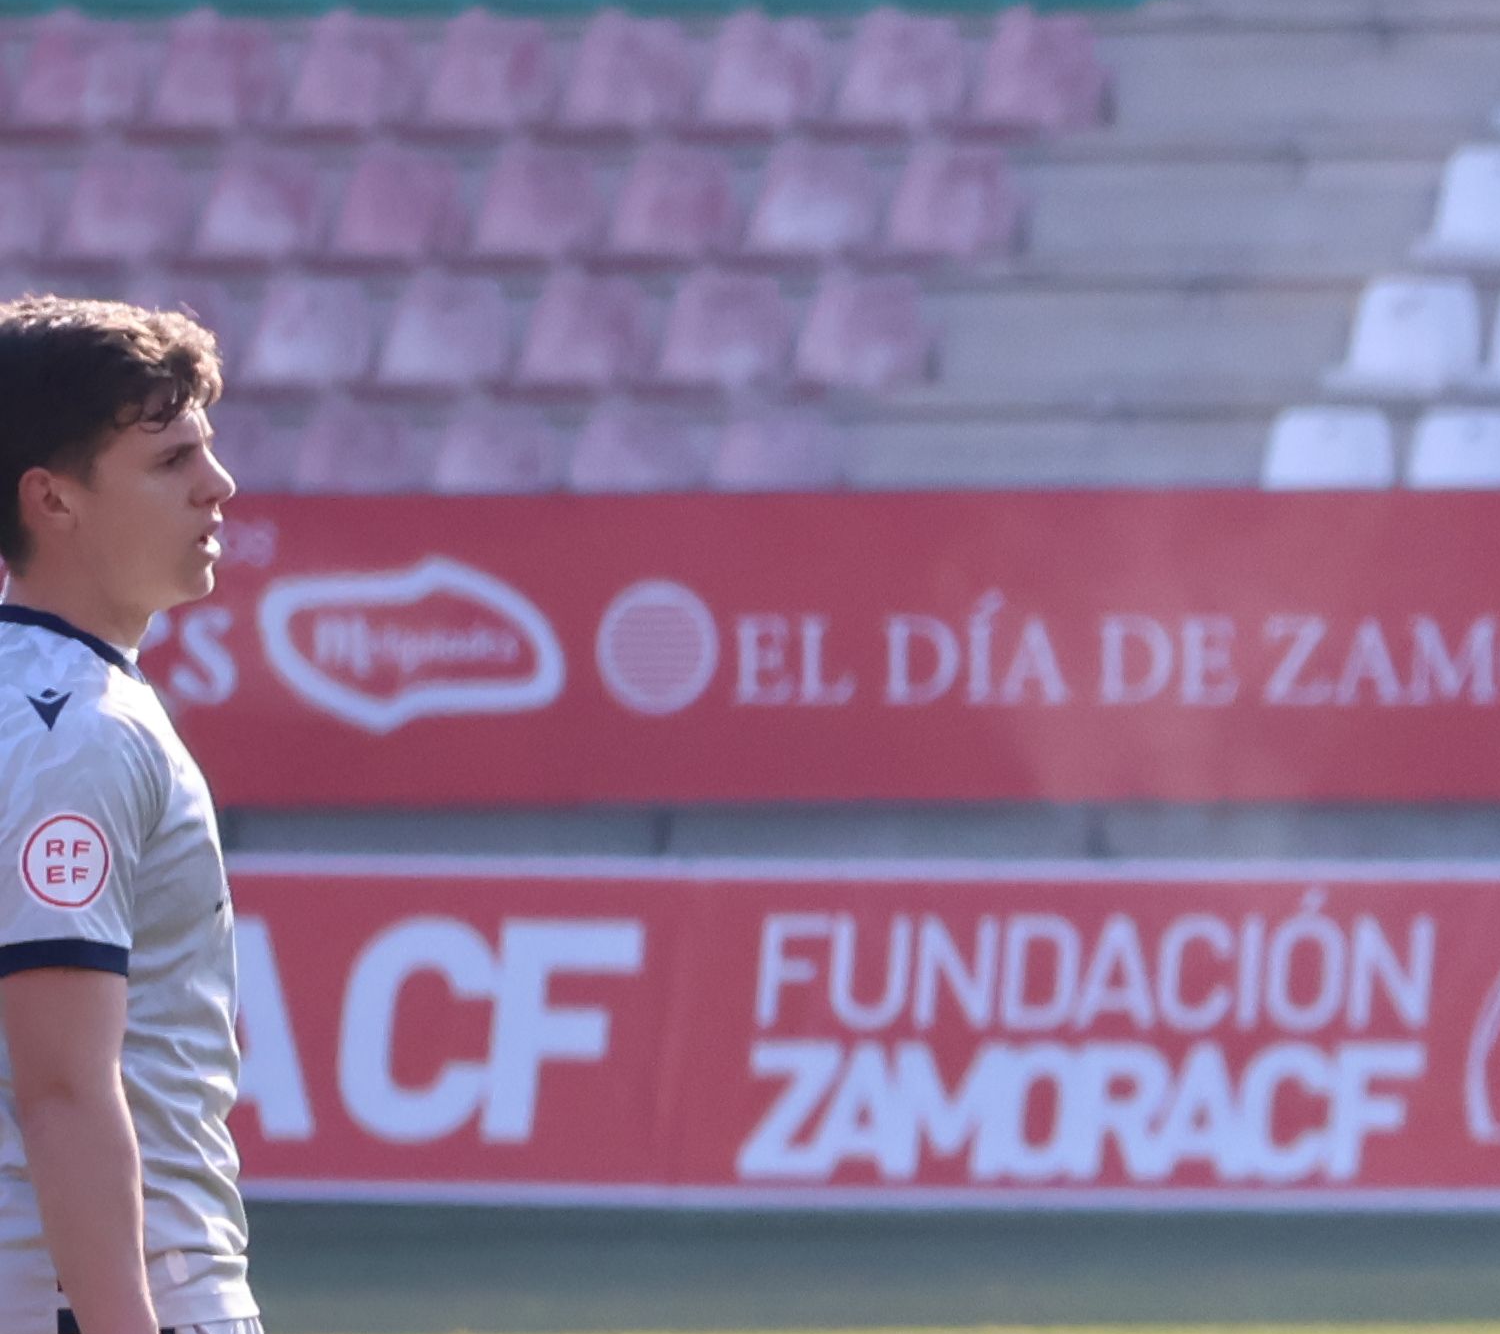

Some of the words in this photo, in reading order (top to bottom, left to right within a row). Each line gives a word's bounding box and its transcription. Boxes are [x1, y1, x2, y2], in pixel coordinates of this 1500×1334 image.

[736, 614, 854, 707] EL
[884, 589, 1068, 708] DÍA
[1098, 614, 1238, 708] DE
[755, 885, 1437, 1032] FUNDACIÓN
[735, 1039, 1430, 1183] ZAMORACF
